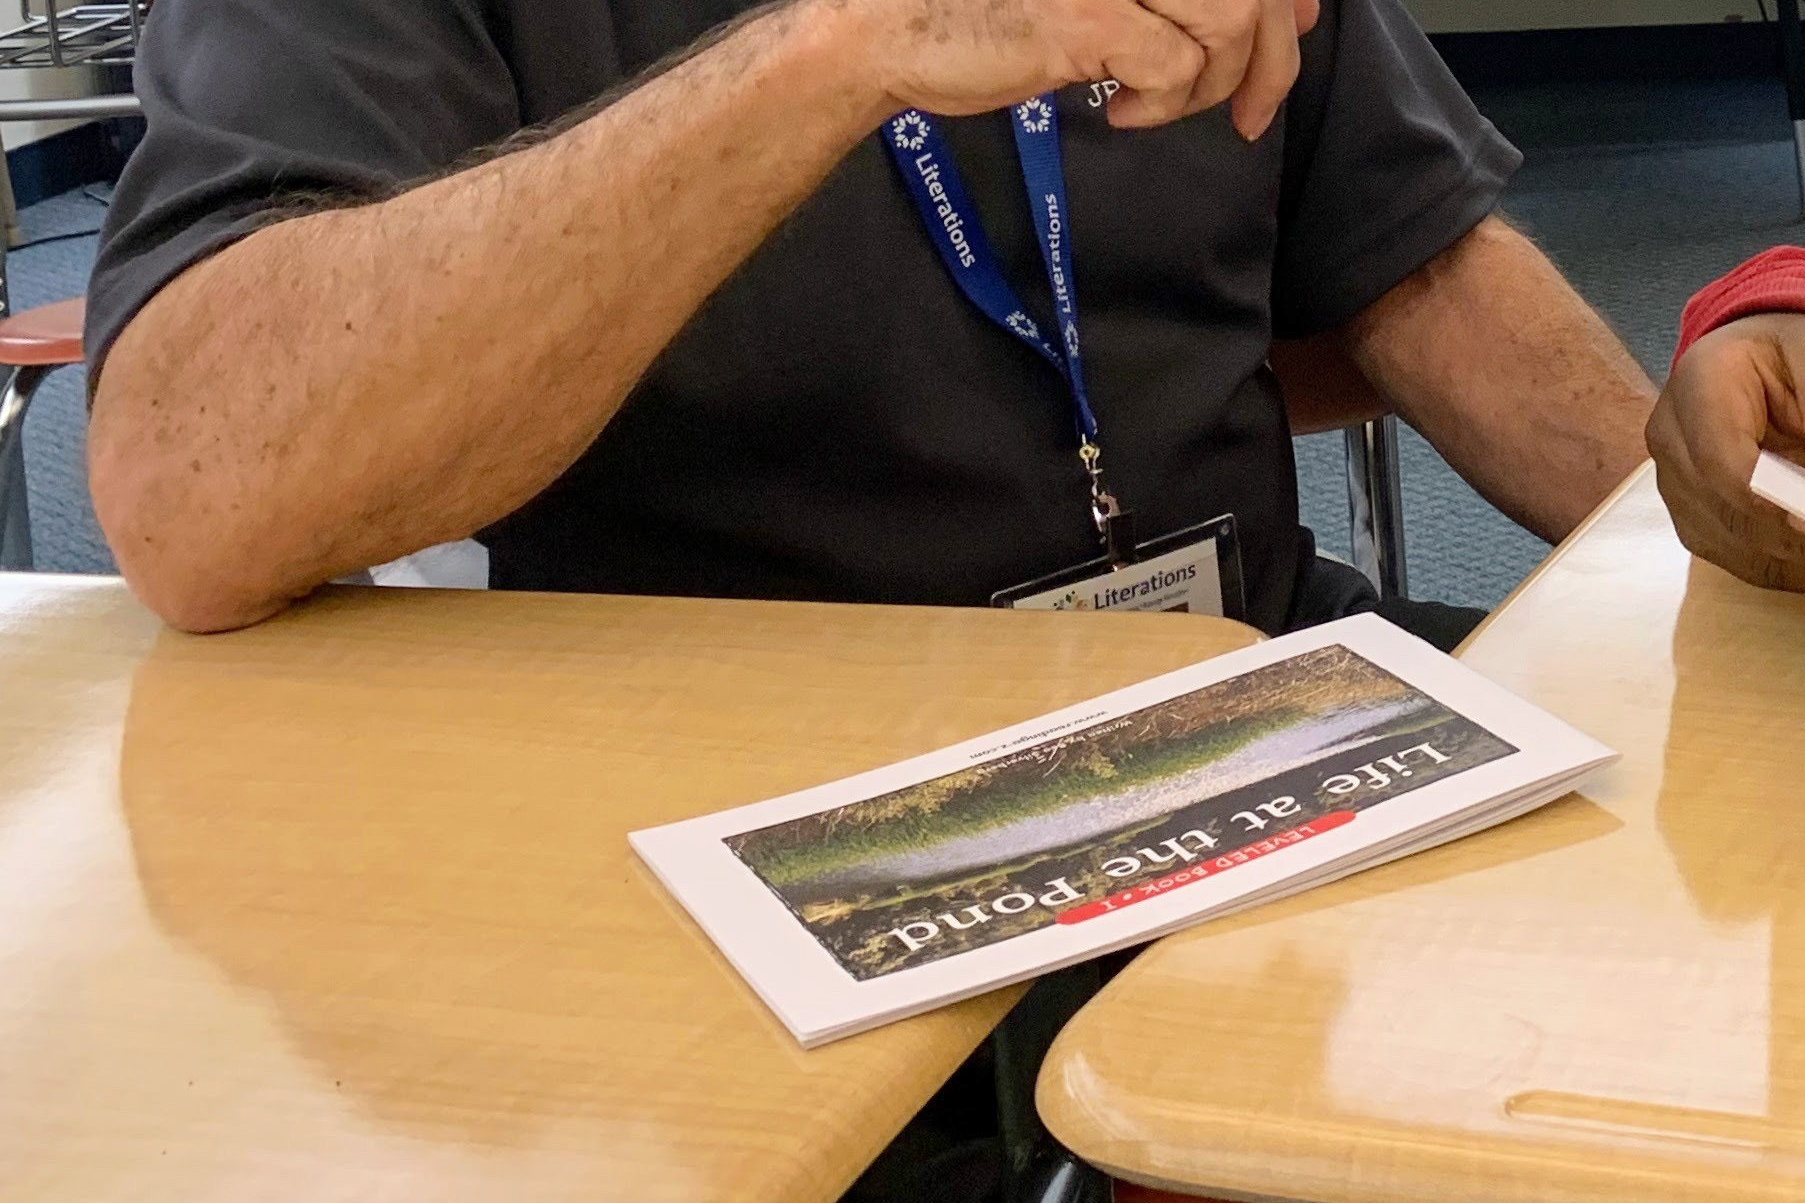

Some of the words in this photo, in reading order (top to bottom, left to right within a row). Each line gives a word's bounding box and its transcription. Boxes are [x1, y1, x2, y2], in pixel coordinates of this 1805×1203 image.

[915, 152, 976, 268] Literations
[1045, 193, 1072, 313] Literations
[1094, 564, 1196, 610] Literations
[1322, 742, 1452, 792] Life
[1230, 795, 1301, 832] at
[1101, 829, 1219, 878] the
[1215, 825, 1316, 868] LEVELED
[1139, 867, 1209, 896] BOOK
[887, 876, 1086, 952] Pond
